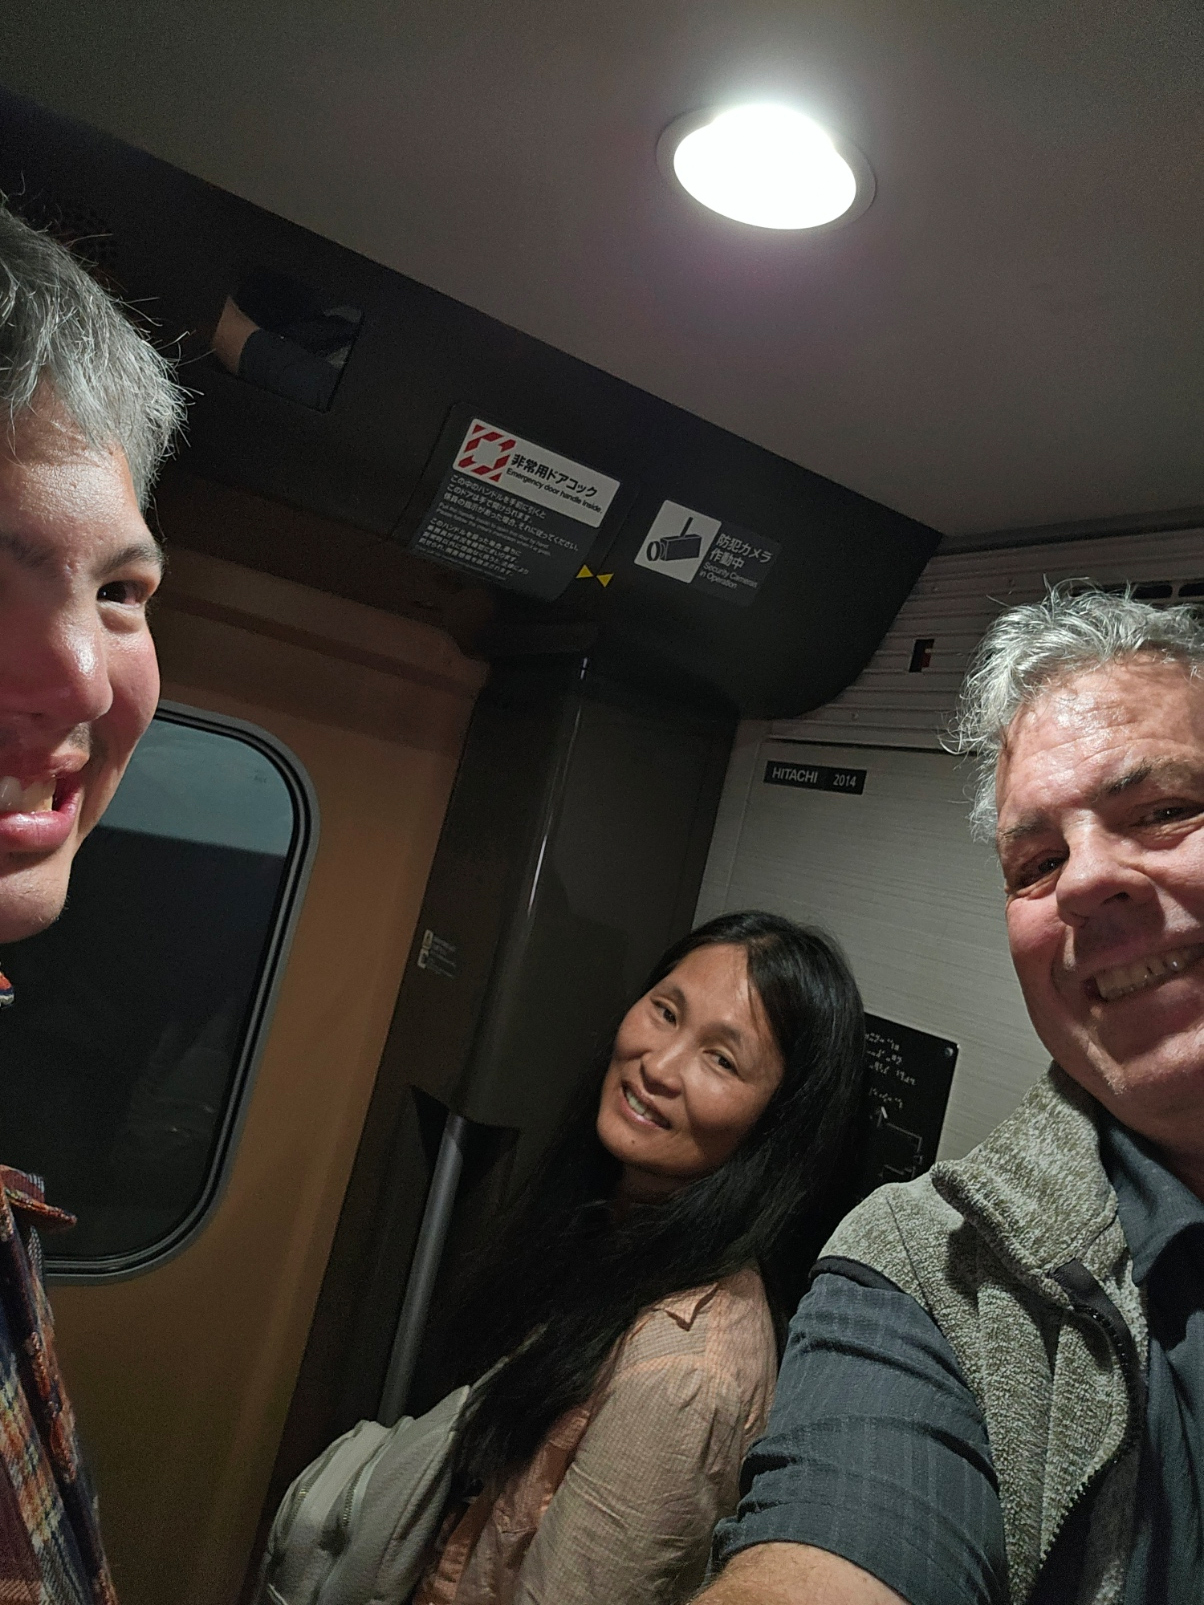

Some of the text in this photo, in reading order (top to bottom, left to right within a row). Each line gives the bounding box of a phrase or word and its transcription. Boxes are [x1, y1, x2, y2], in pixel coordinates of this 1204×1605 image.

[506, 467, 544, 489] Emergency
[543, 484, 560, 495] door
[559, 490, 582, 503] handle
[511, 453, 598, 498] 非常用ドアコック
[709, 548, 745, 569] 作動中
[716, 533, 773, 563] 防犯カメラ
[703, 561, 730, 578] Security
[772, 767, 857, 787] HITACHI 2014
